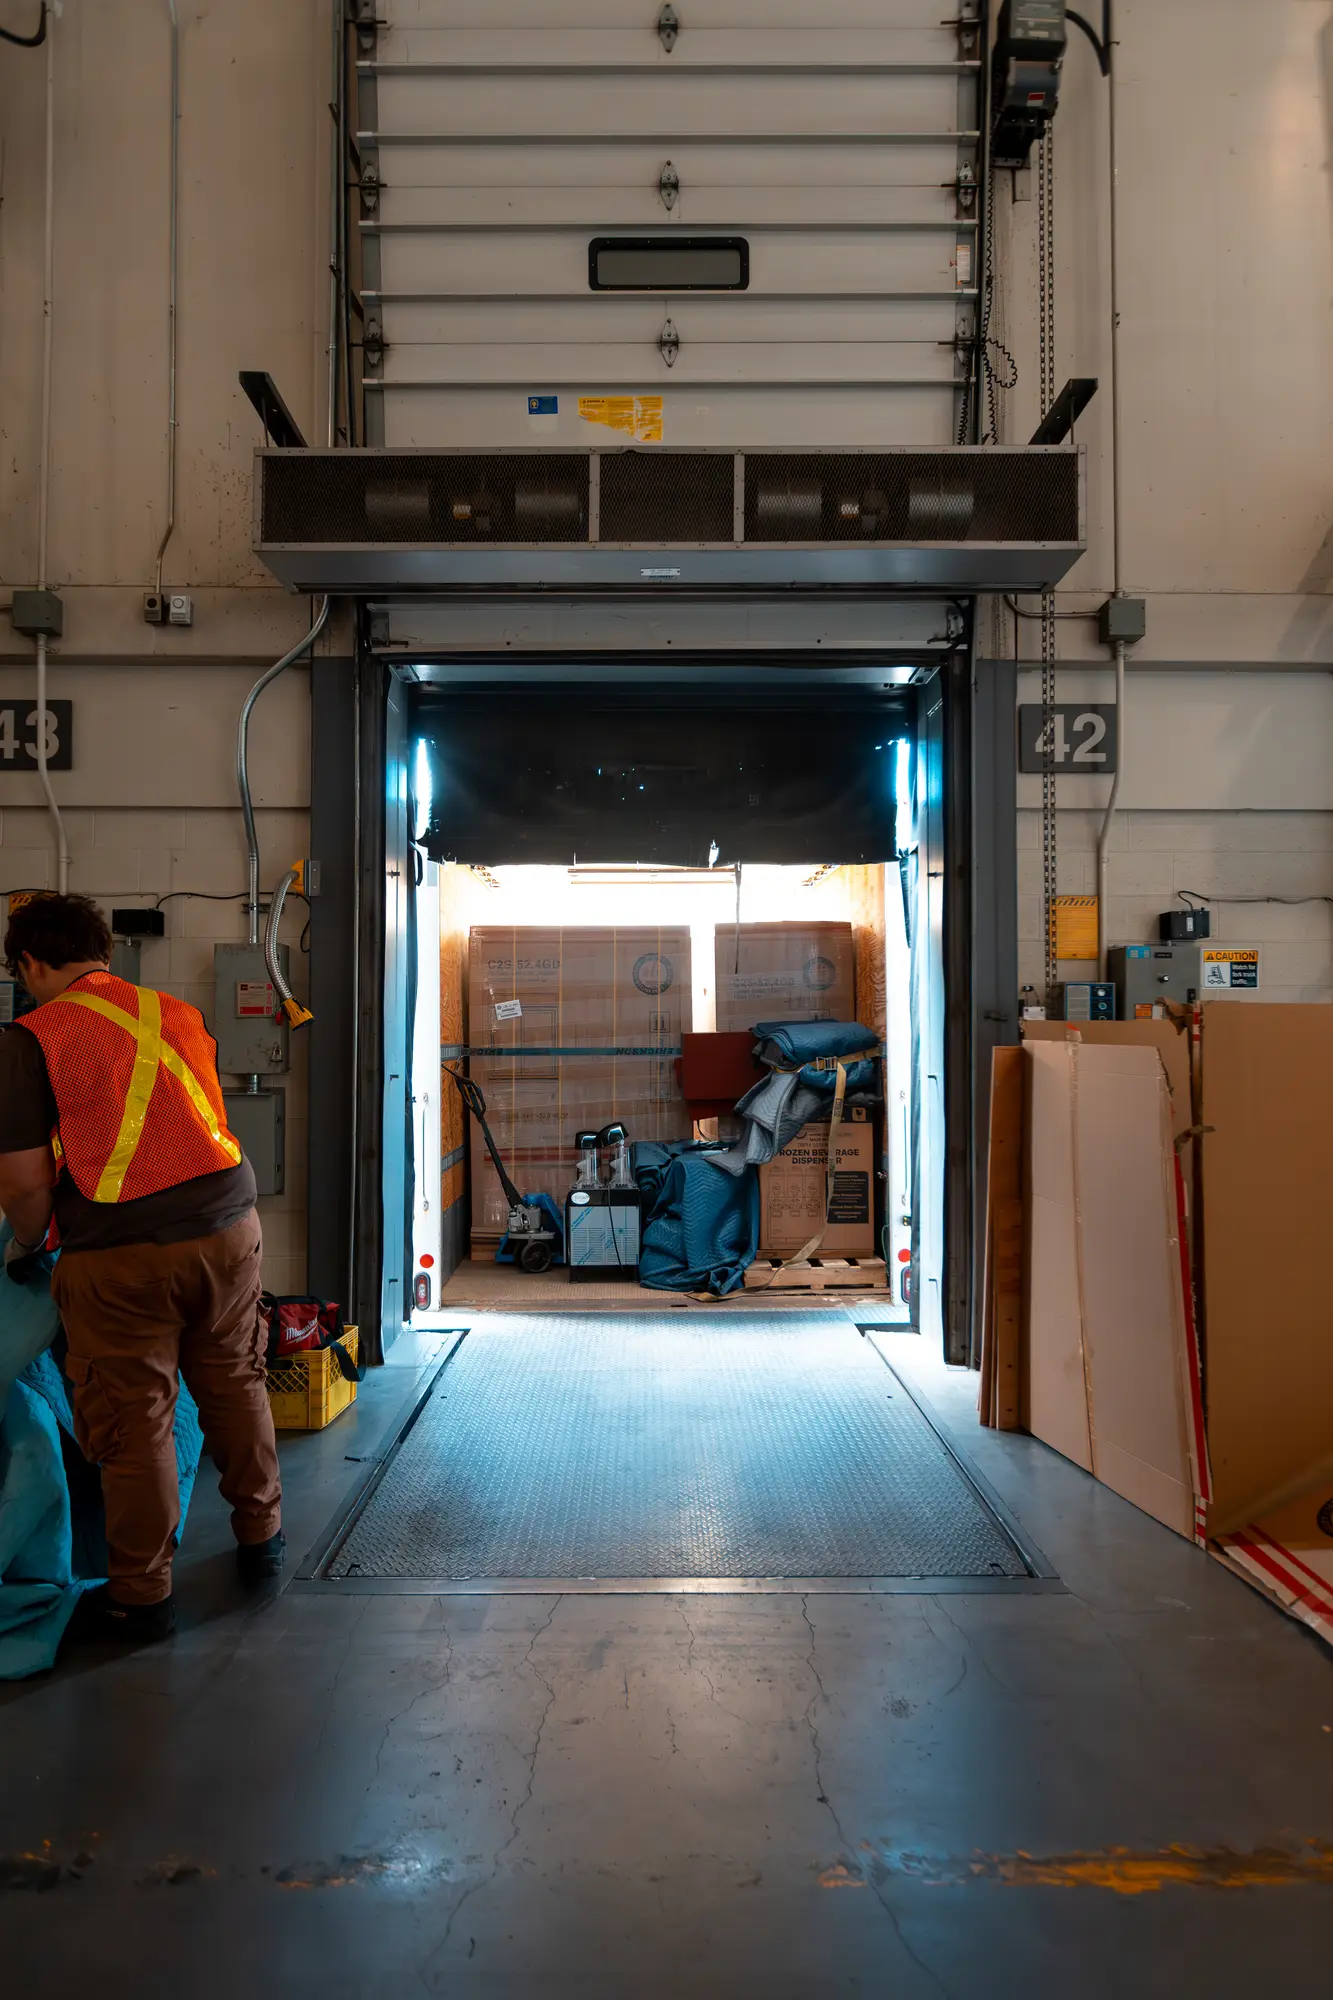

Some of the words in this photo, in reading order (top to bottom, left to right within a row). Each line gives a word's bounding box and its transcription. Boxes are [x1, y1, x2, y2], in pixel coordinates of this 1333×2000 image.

[0, 710, 59, 759] 43
[1035, 712, 1106, 762] 42
[1215, 952, 1256, 961] CAUTION
[487, 959, 561, 970] C2S52.4GD
[779, 1148, 811, 1157] ROZEN
[812, 1148, 860, 1157] BEVRAGE
[792, 1157, 842, 1165] DISPENSR
